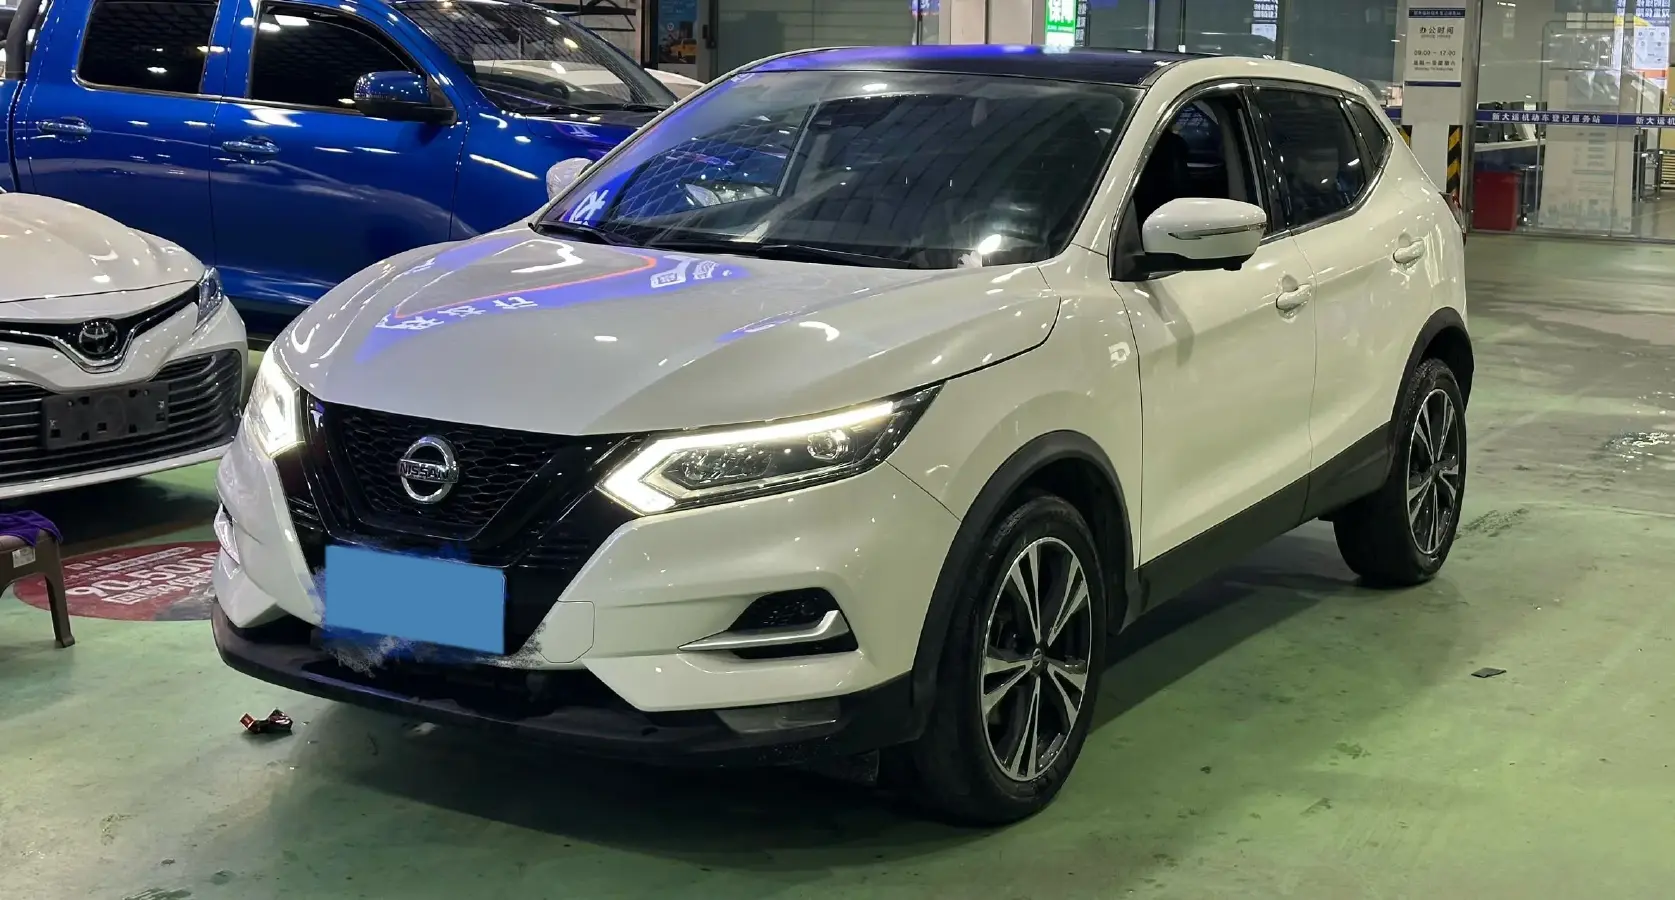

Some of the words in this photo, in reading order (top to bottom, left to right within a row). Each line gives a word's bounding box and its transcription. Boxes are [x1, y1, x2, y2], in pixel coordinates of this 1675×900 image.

[1419, 26, 1454, 35] 办公时间
[1491, 111, 1601, 124] 新大运机动车登记服务站
[400, 461, 449, 480] NISSAN
